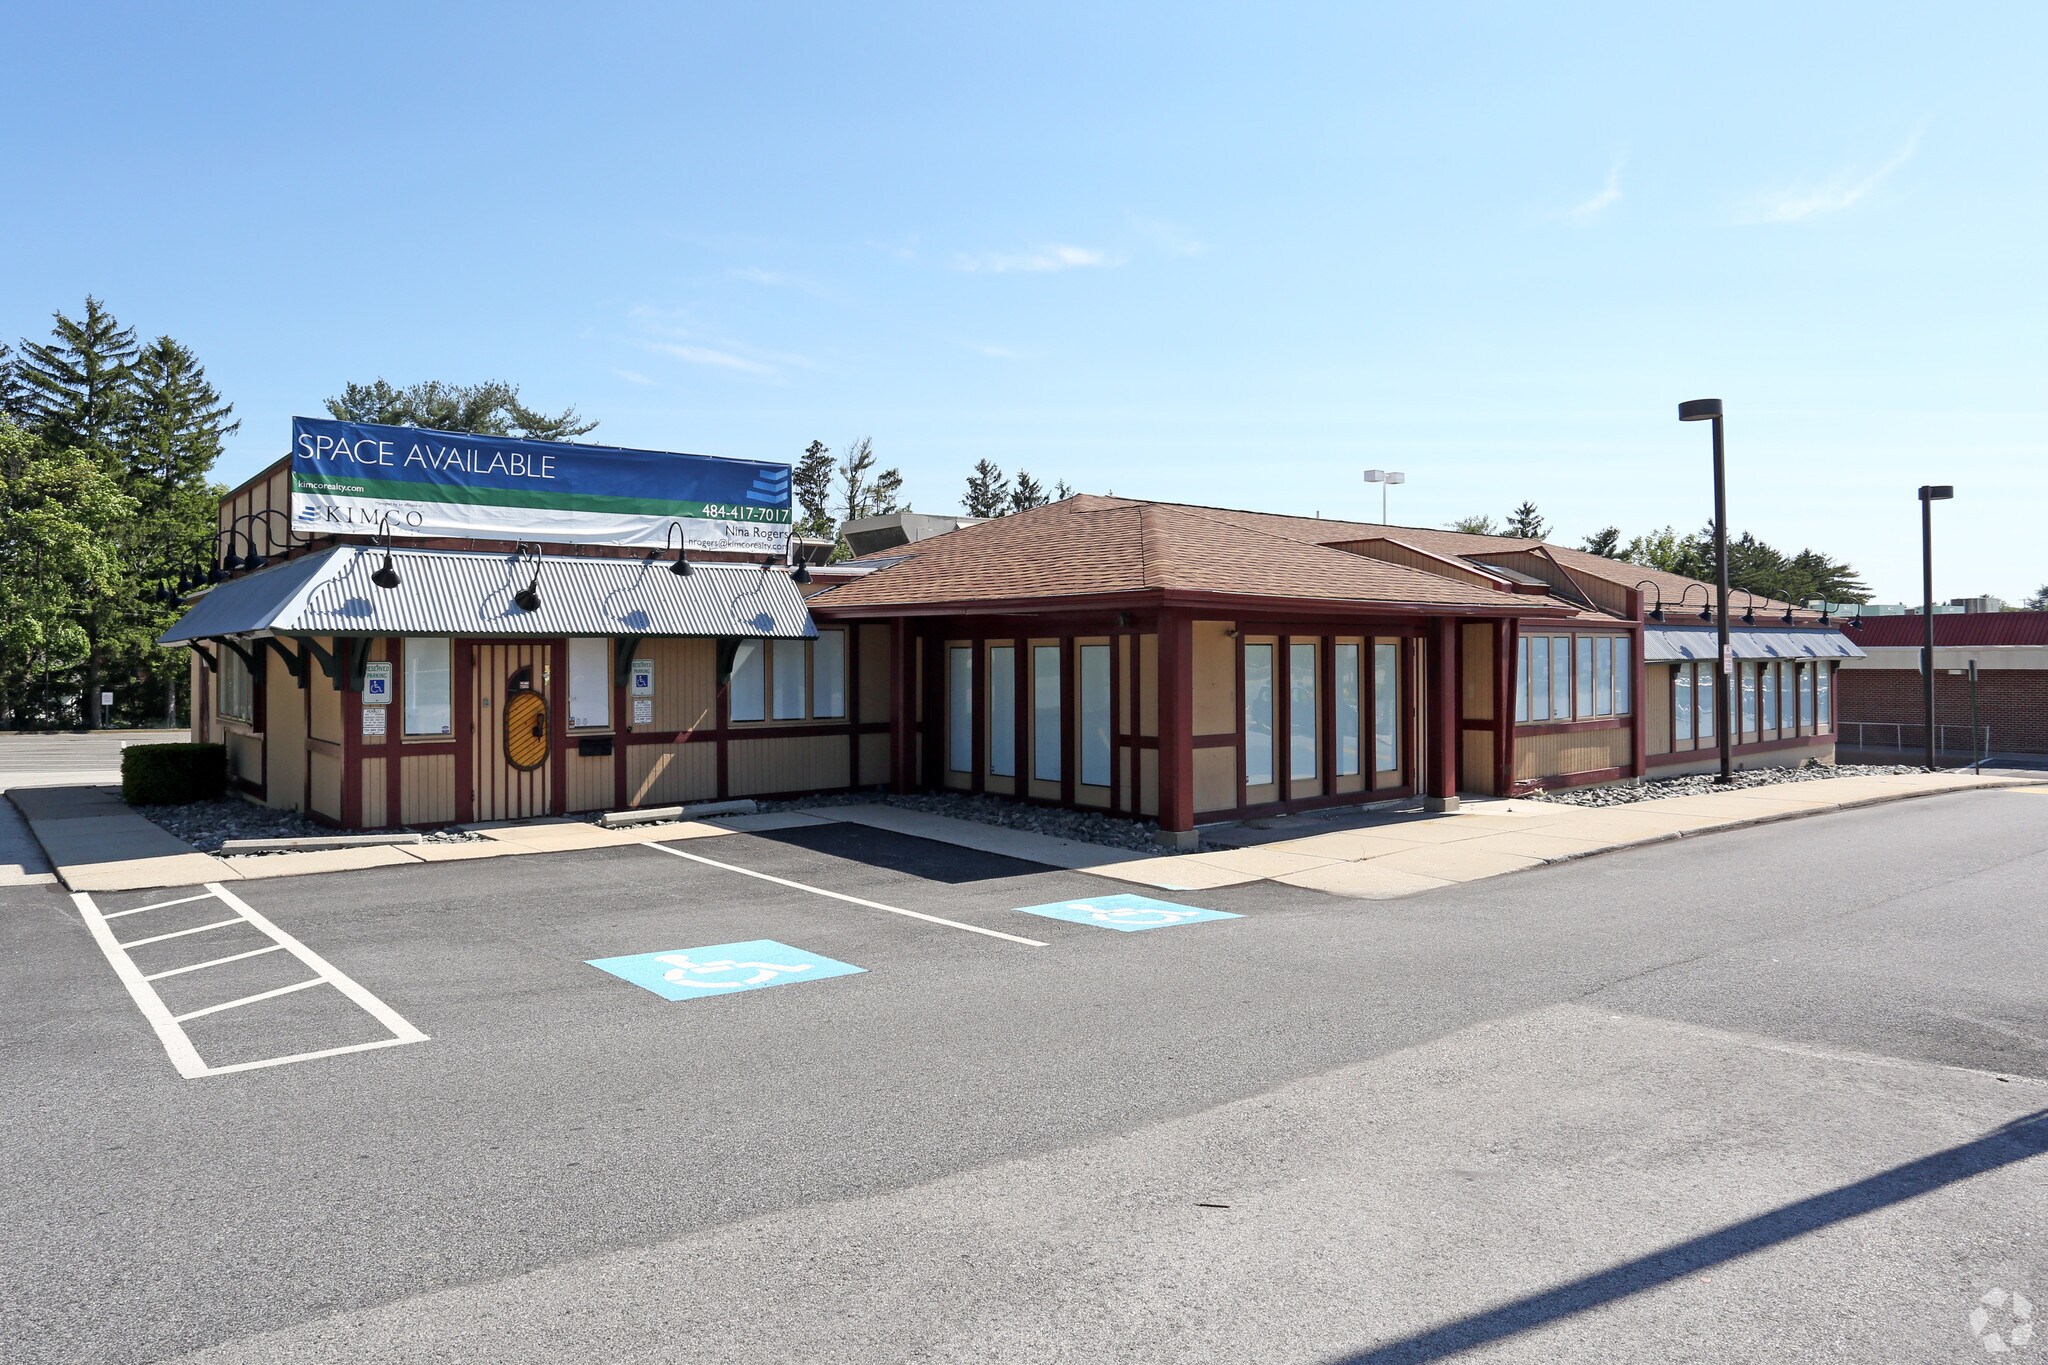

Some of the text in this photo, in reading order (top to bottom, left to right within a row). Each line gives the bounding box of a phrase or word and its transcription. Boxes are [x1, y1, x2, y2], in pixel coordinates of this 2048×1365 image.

[298, 433, 556, 479] SPACE AVAILABLE
[298, 480, 365, 492] kimcorealty.com
[325, 505, 423, 527] KIMCO
[701, 503, 789, 522] 484-417-7017
[725, 525, 789, 541] Nina Rogers
